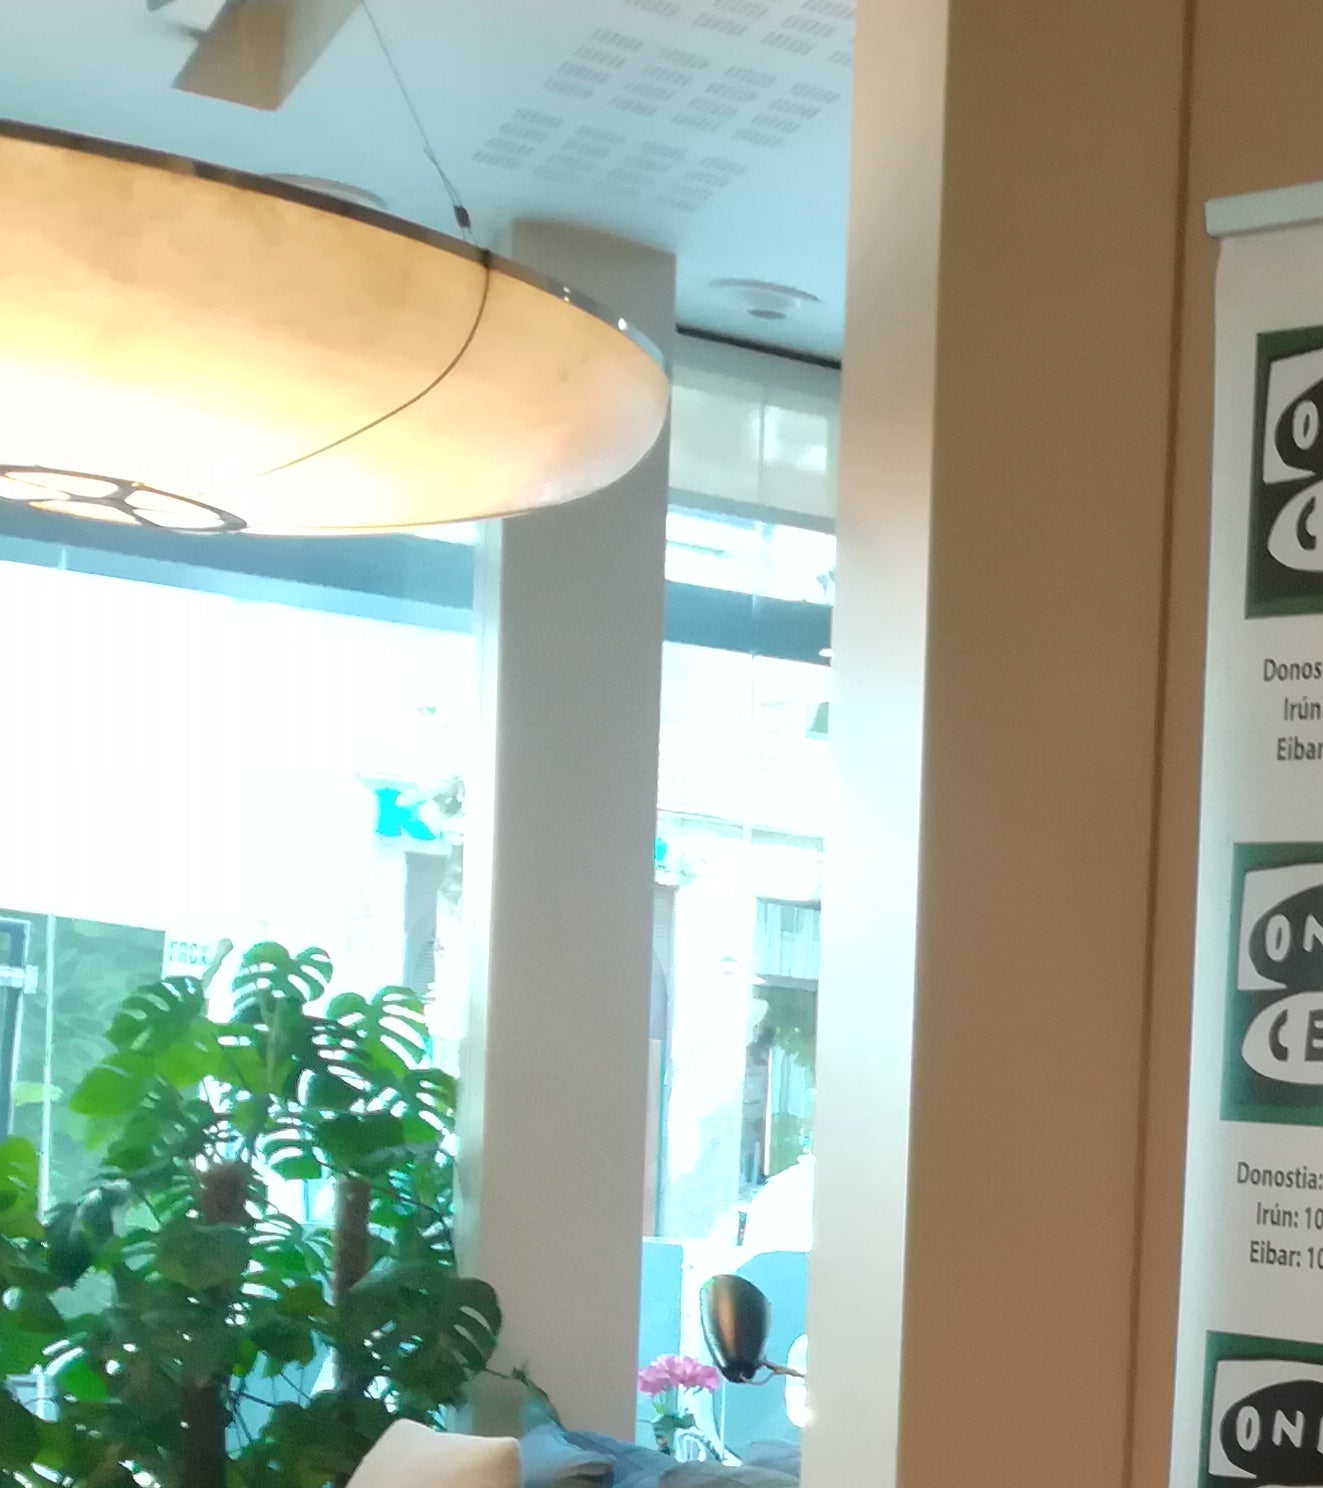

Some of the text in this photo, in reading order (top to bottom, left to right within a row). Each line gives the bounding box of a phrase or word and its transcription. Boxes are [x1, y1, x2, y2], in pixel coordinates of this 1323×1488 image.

[1236, 1161, 1323, 1191] Donostia:
[1256, 1201, 1299, 1229] Irún:
[1249, 1239, 1302, 1268] Eibar:
